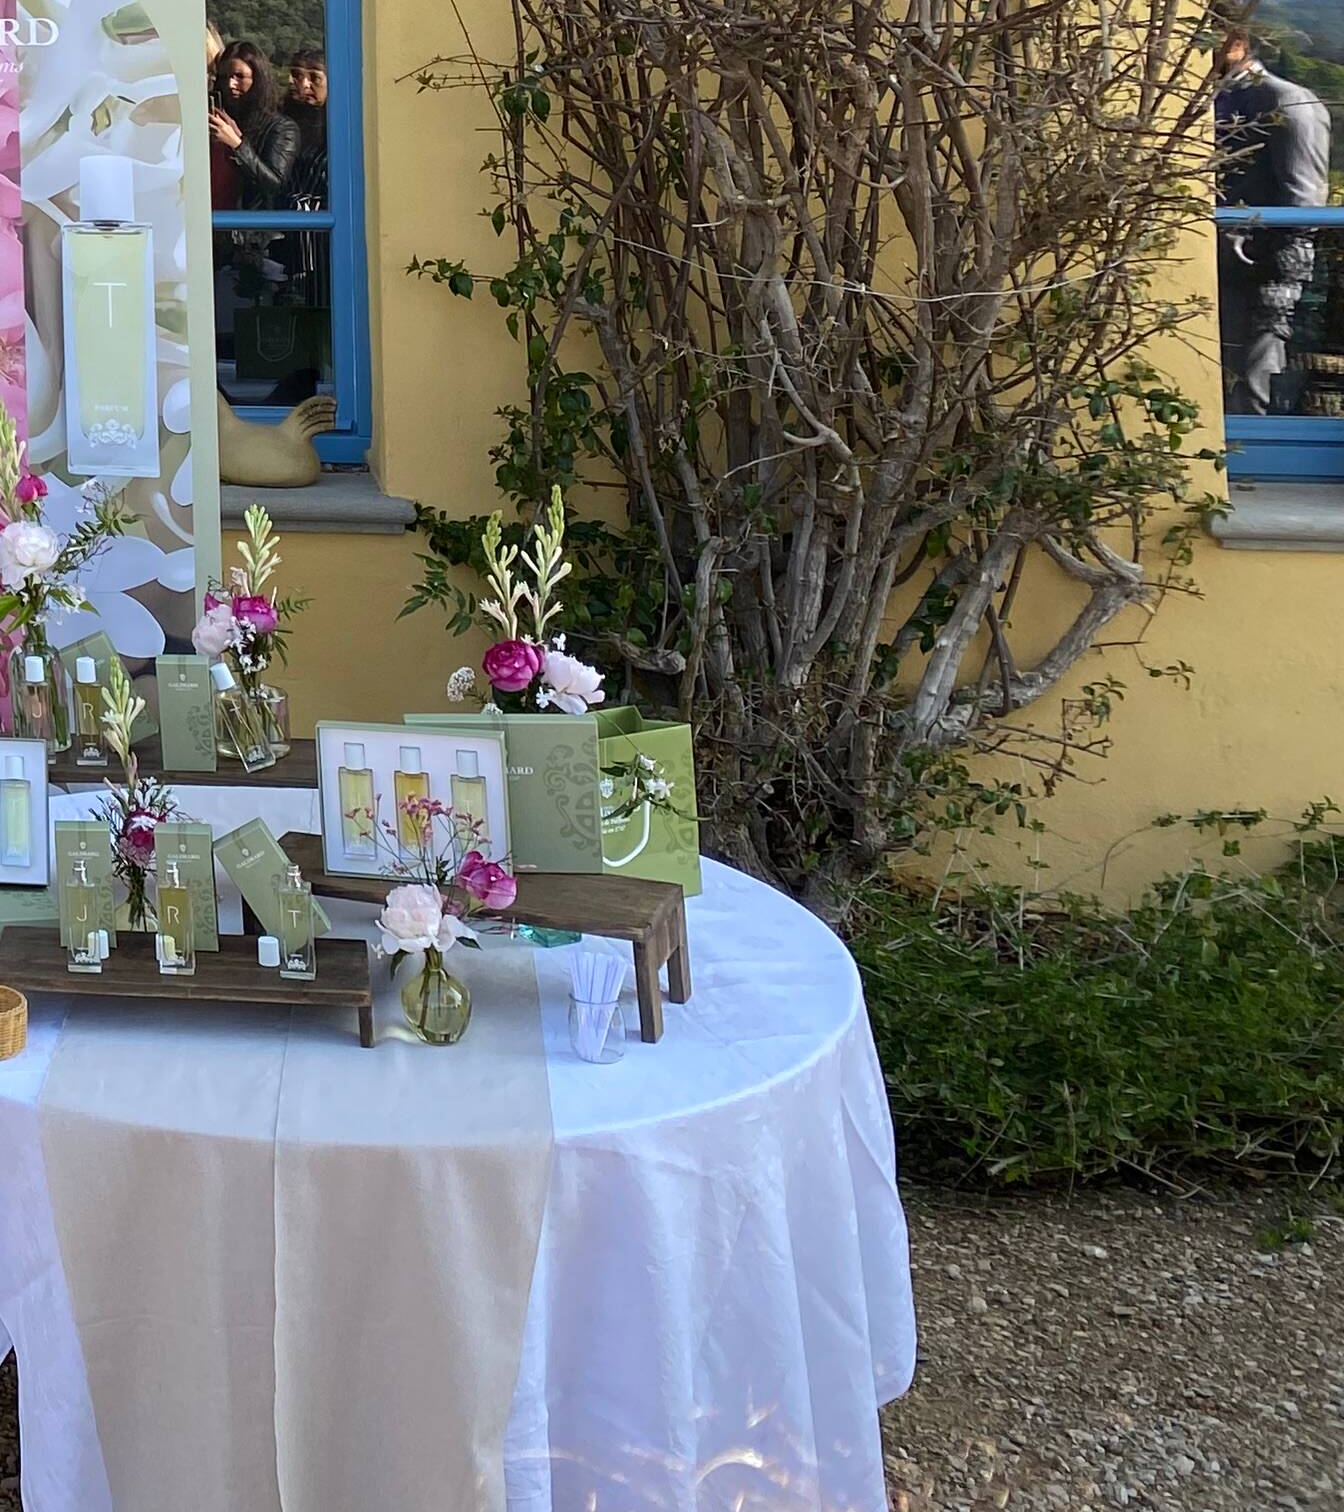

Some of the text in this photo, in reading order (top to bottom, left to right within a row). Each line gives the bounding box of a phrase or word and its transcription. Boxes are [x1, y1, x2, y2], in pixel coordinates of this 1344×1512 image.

[93, 282, 127, 328] T
[168, 906, 180, 924] R
[287, 910, 301, 928] T
